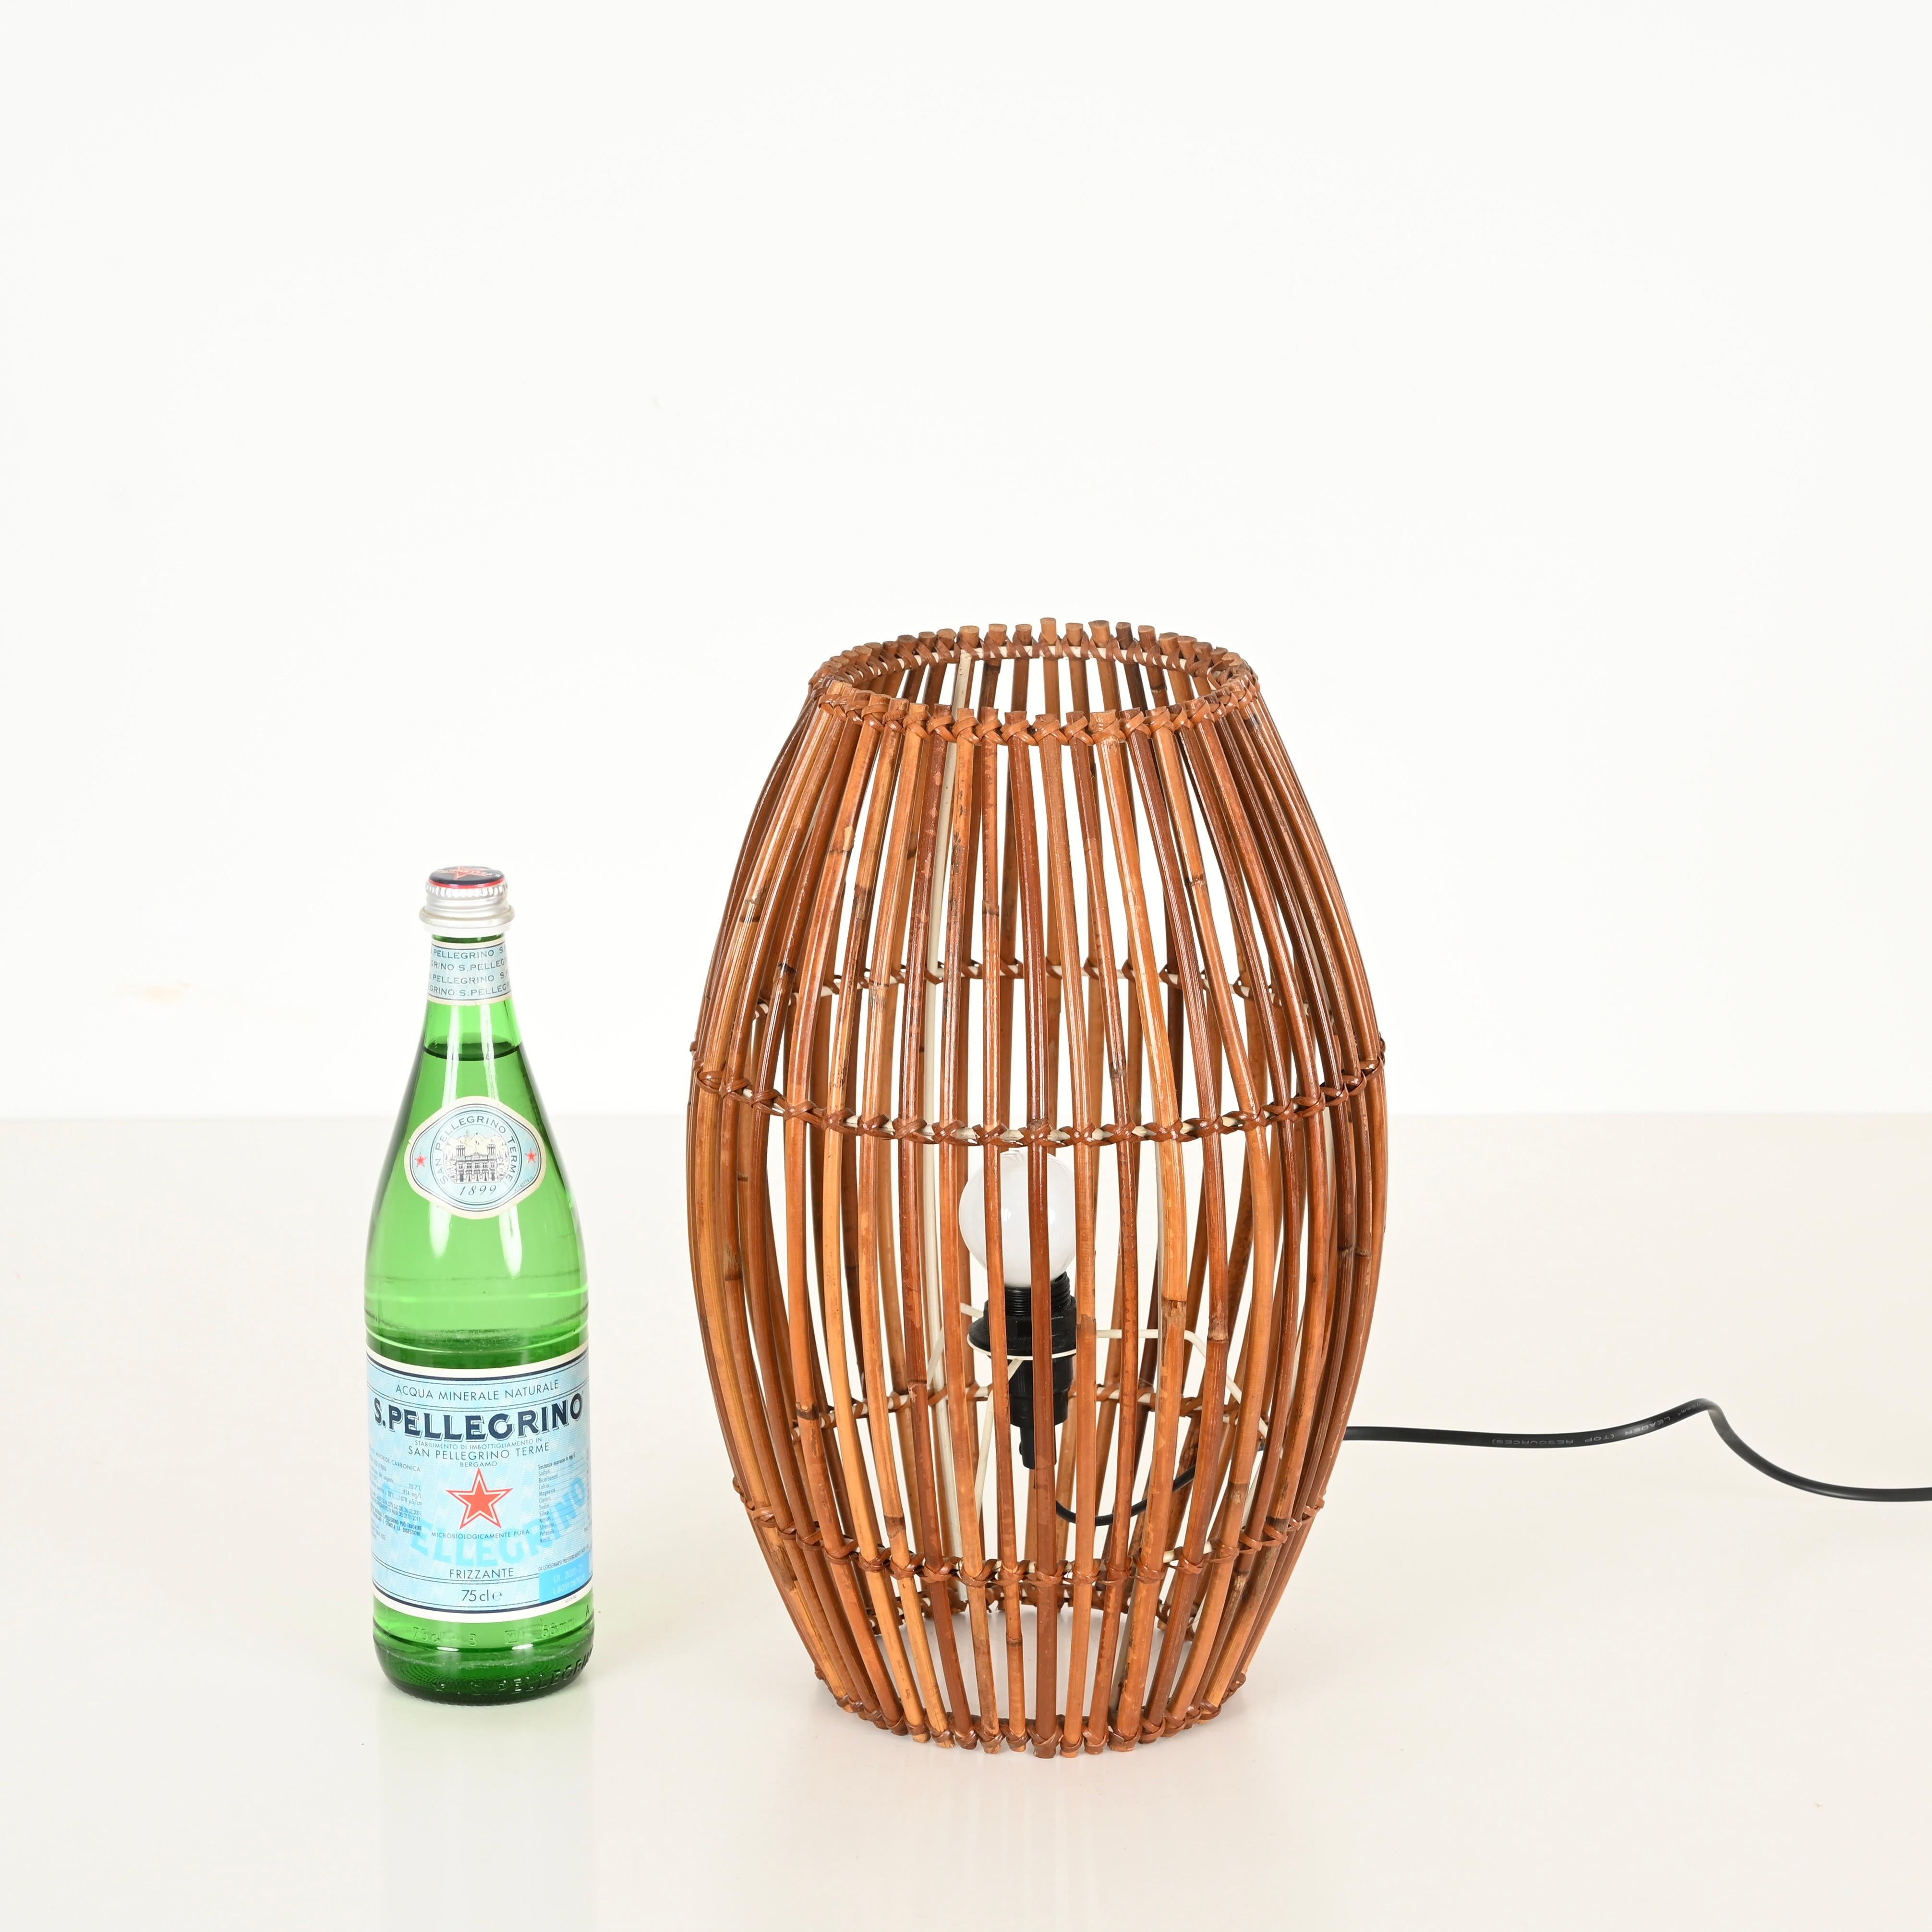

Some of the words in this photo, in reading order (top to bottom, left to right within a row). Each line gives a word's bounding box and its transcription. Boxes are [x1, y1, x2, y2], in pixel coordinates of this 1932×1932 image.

[435, 1116, 507, 1151] PELLEGRINO
[507, 1136, 518, 1182] TERME
[435, 1159, 448, 1184] SAN
[459, 1184, 497, 1196] 1899
[396, 1384, 434, 1400] ACQUA
[439, 1389, 500, 1401] MINERALE
[505, 1379, 559, 1399] NATURALE
[373, 1392, 584, 1443] S.PELLEGRINO
[1625, 1416, 1671, 1435] LEADER
[408, 1446, 430, 1457] SAN
[436, 1449, 509, 1460] PELLEGRINO
[515, 1442, 549, 1457] TERME
[415, 1440, 458, 1450] STABILIMENTO
[469, 1438, 533, 1450] IMBOTTIGLIAMENTO
[391, 1460, 421, 1472] CARBONICA
[431, 1532, 511, 1540] MICROBIOLOGICAMENTE
[449, 1568, 514, 1580] FRIZZANTE
